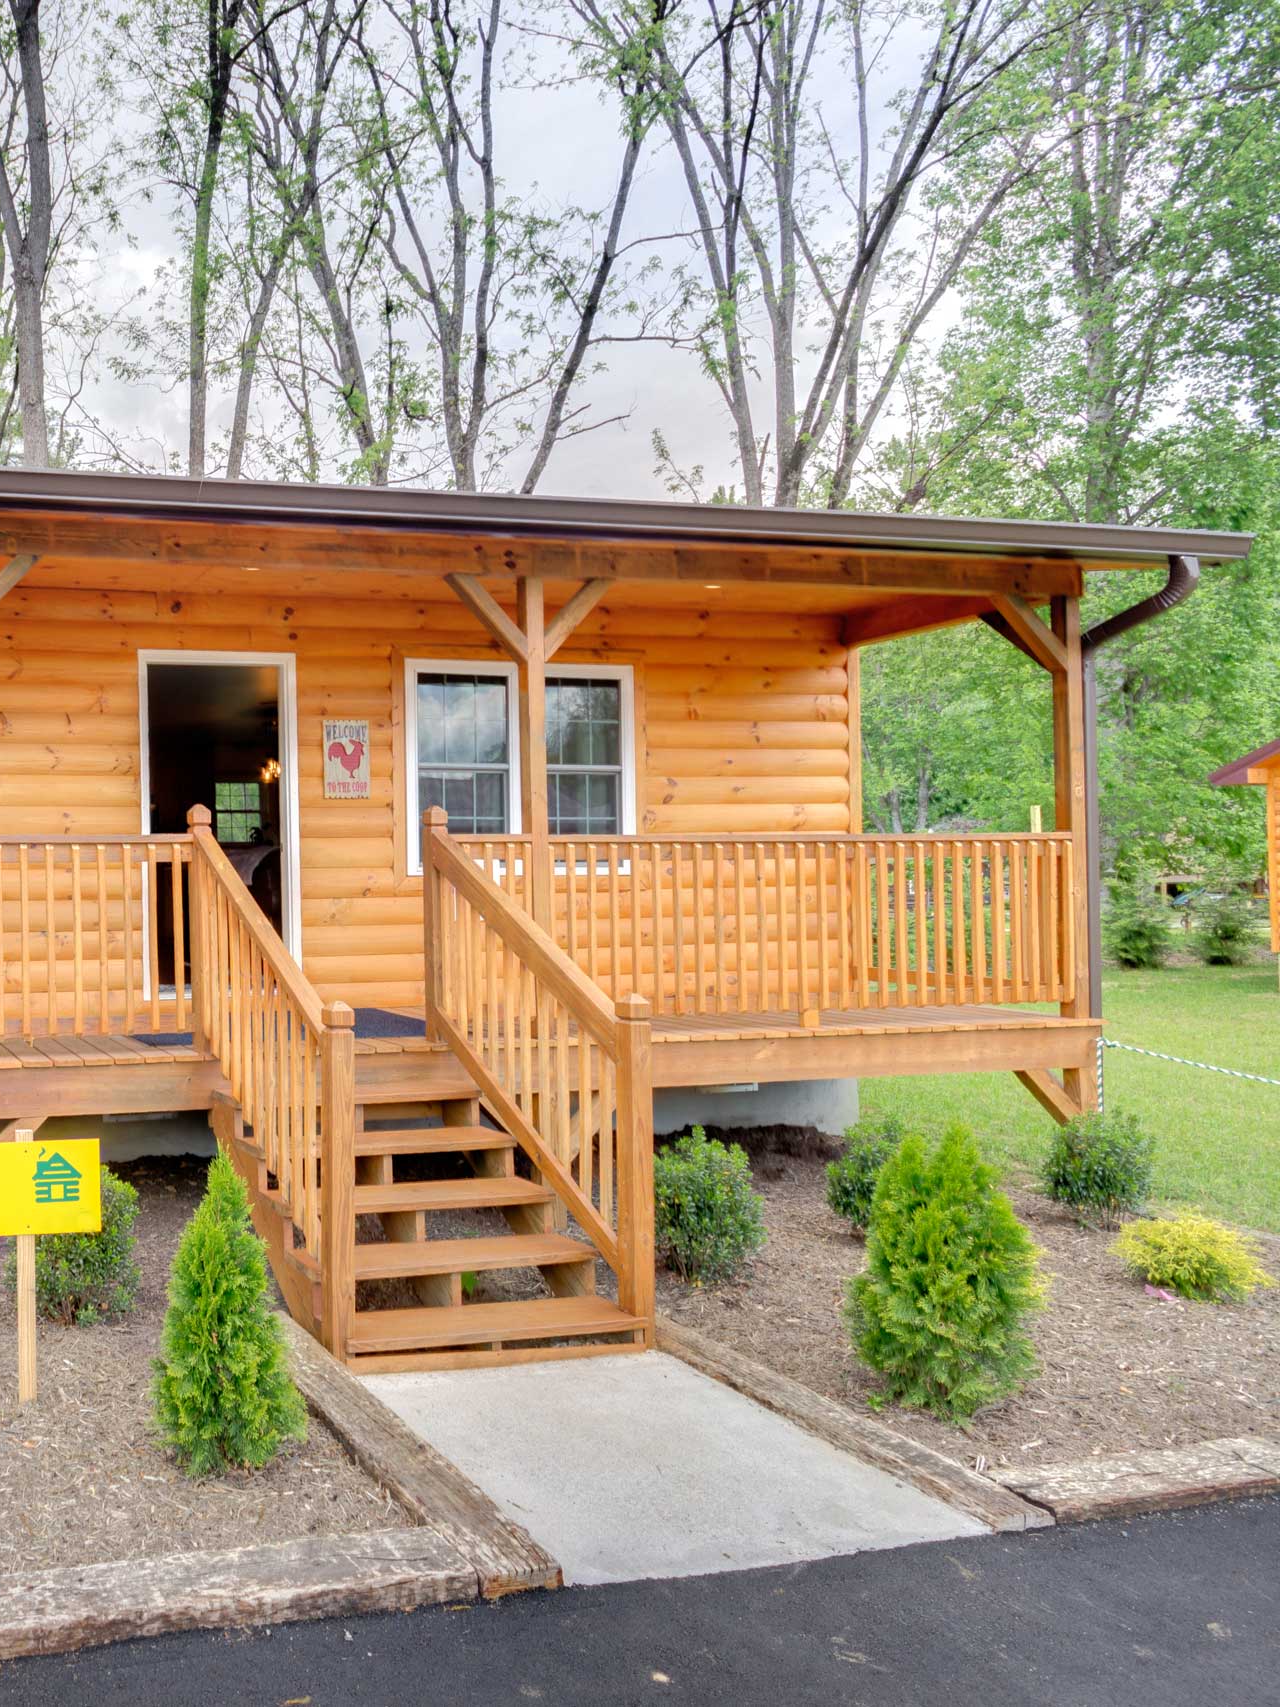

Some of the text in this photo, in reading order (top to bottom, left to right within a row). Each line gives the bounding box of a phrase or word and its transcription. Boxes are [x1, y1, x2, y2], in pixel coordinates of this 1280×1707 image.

[325, 724, 367, 743] WELCOME
[327, 782, 368, 793] TO THE COOP
